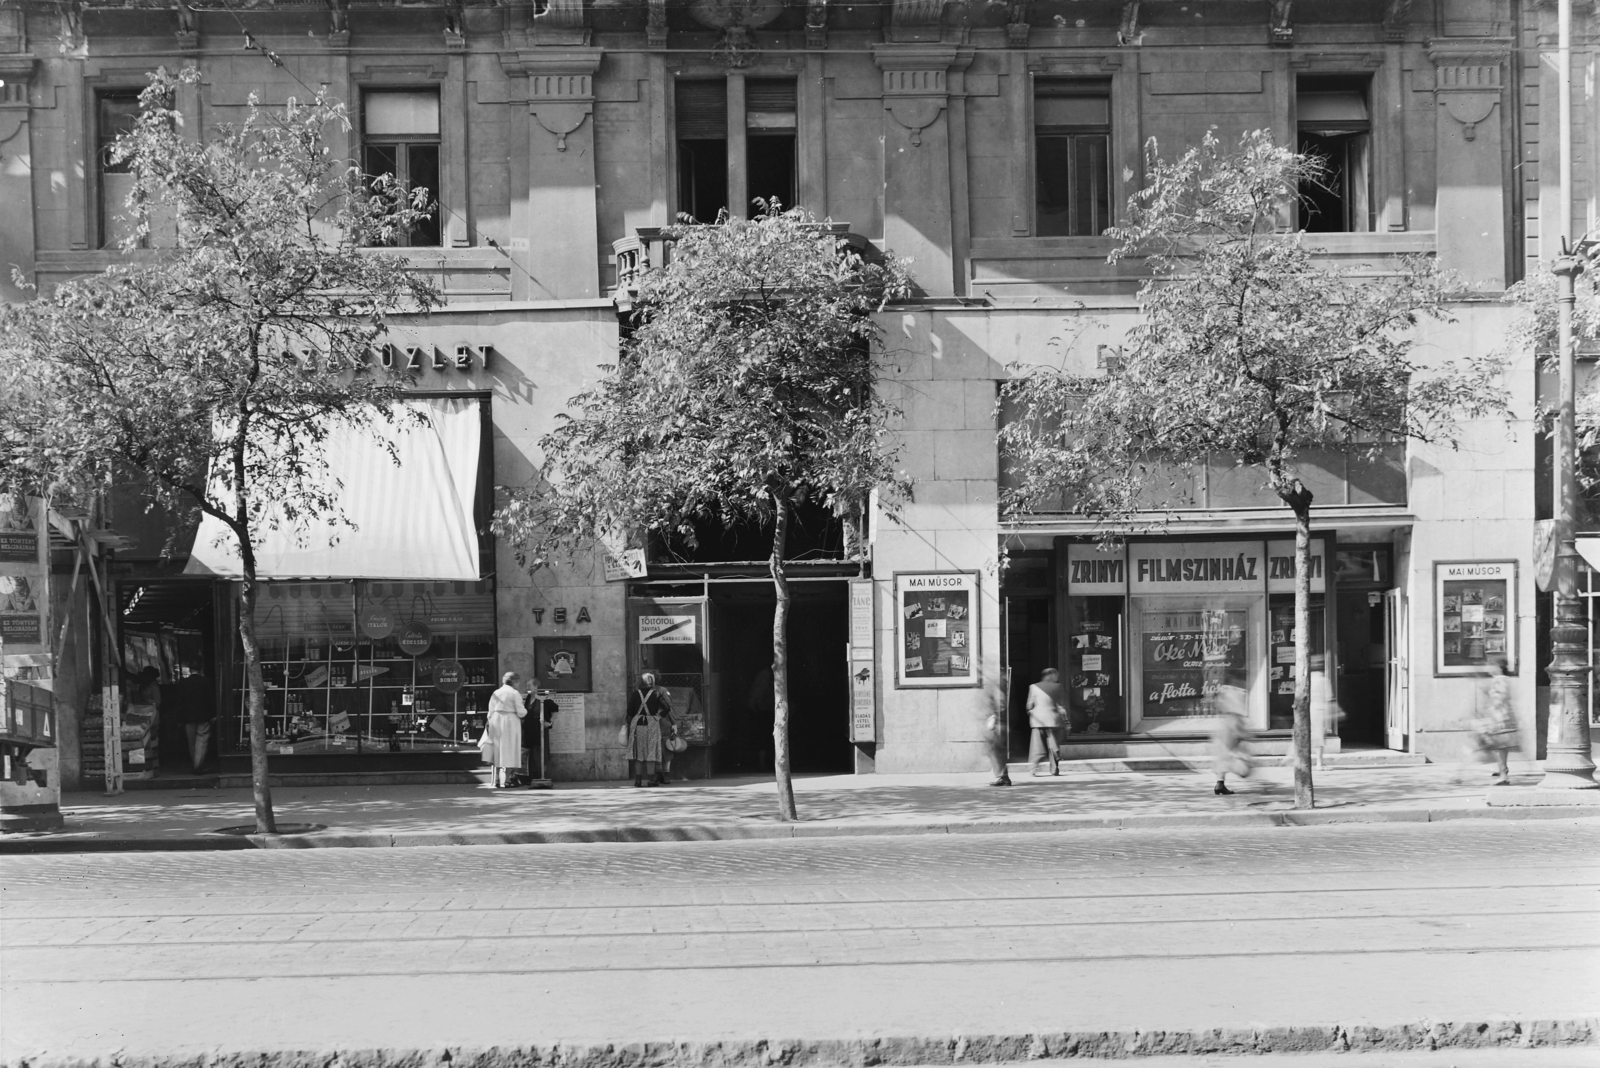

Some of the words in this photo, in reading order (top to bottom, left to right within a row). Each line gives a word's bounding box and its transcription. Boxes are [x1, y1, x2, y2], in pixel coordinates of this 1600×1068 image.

[1071, 559, 1123, 584] ZRINYI
[1137, 553, 1258, 582] FILMSZINHÁZ
[1270, 555, 1321, 579] ZRIYI
[1448, 568, 1464, 576] MAI
[909, 578, 926, 587] MAI
[532, 606, 592, 625] TEA
[1165, 616, 1183, 628] MAI
[1154, 642, 1187, 662] Oké
[1149, 691, 1159, 701] a
[1159, 682, 1197, 705] Flotta
